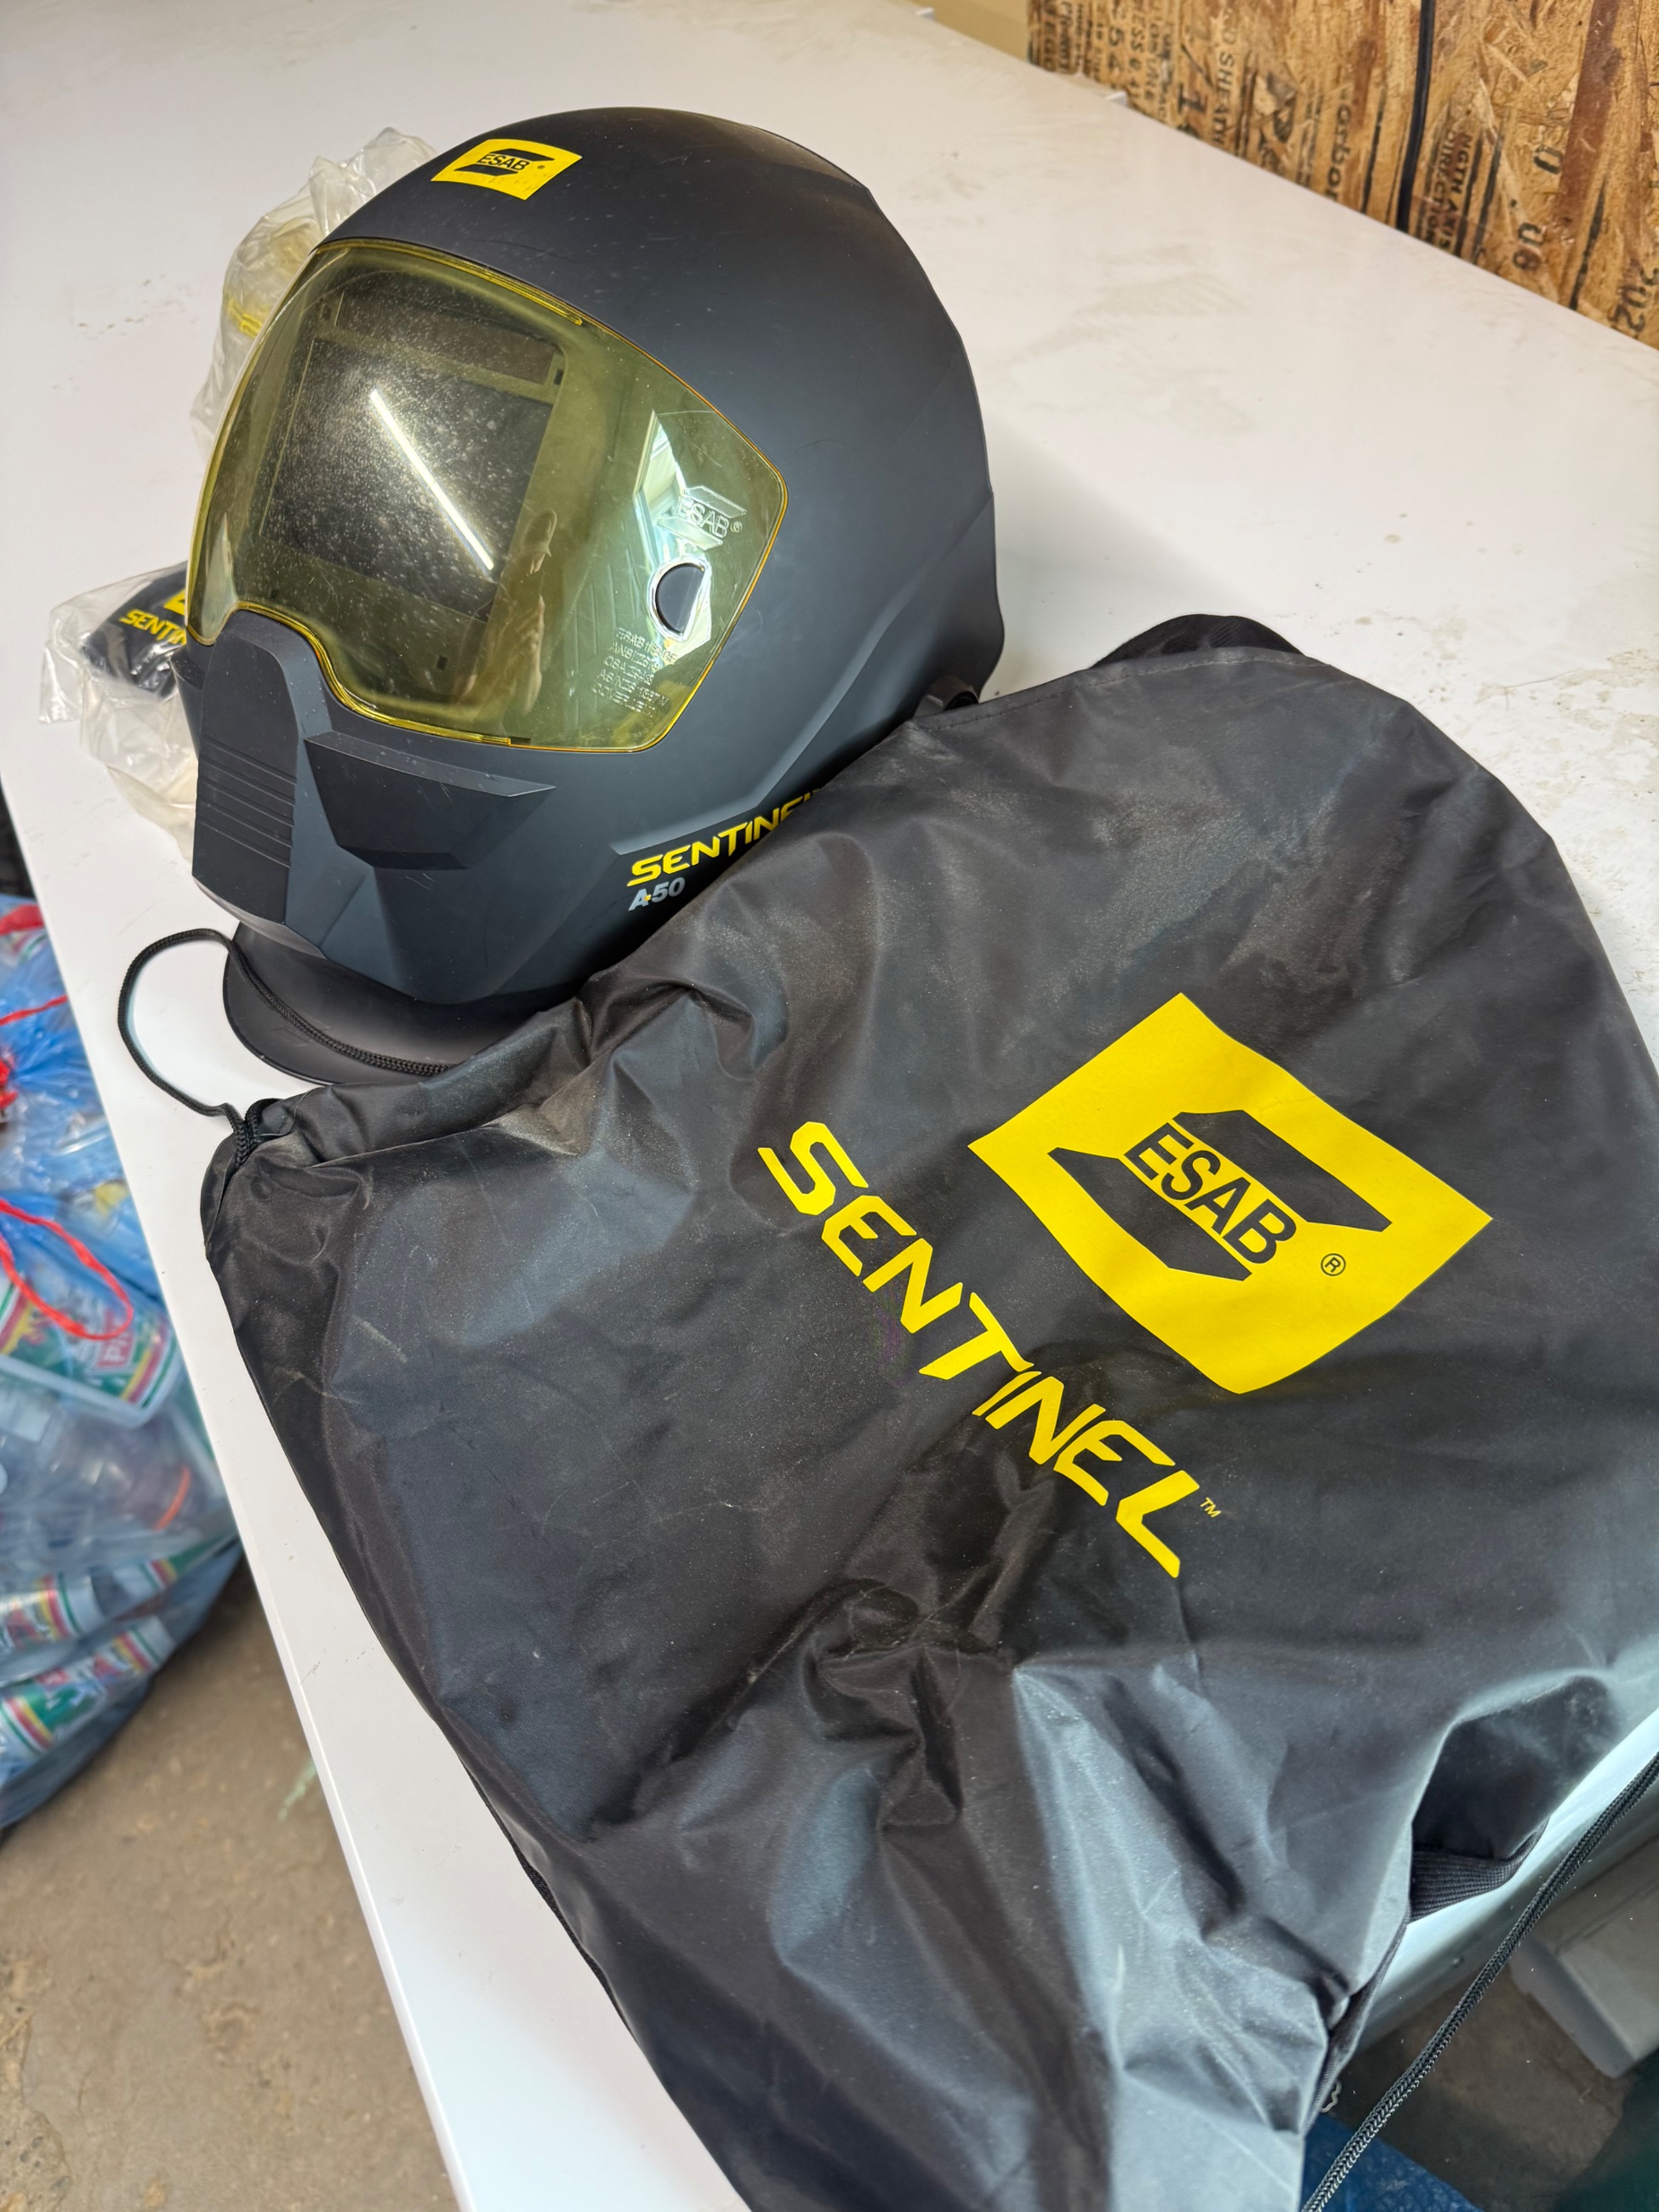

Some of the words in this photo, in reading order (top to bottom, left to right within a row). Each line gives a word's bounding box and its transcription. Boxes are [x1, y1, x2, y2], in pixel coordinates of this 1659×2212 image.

[476, 154, 530, 171] ESAB
[680, 496, 730, 539] ESAB
[1123, 1121, 1297, 1265] ESAB
[757, 1120, 1200, 1579] SENTINEL
